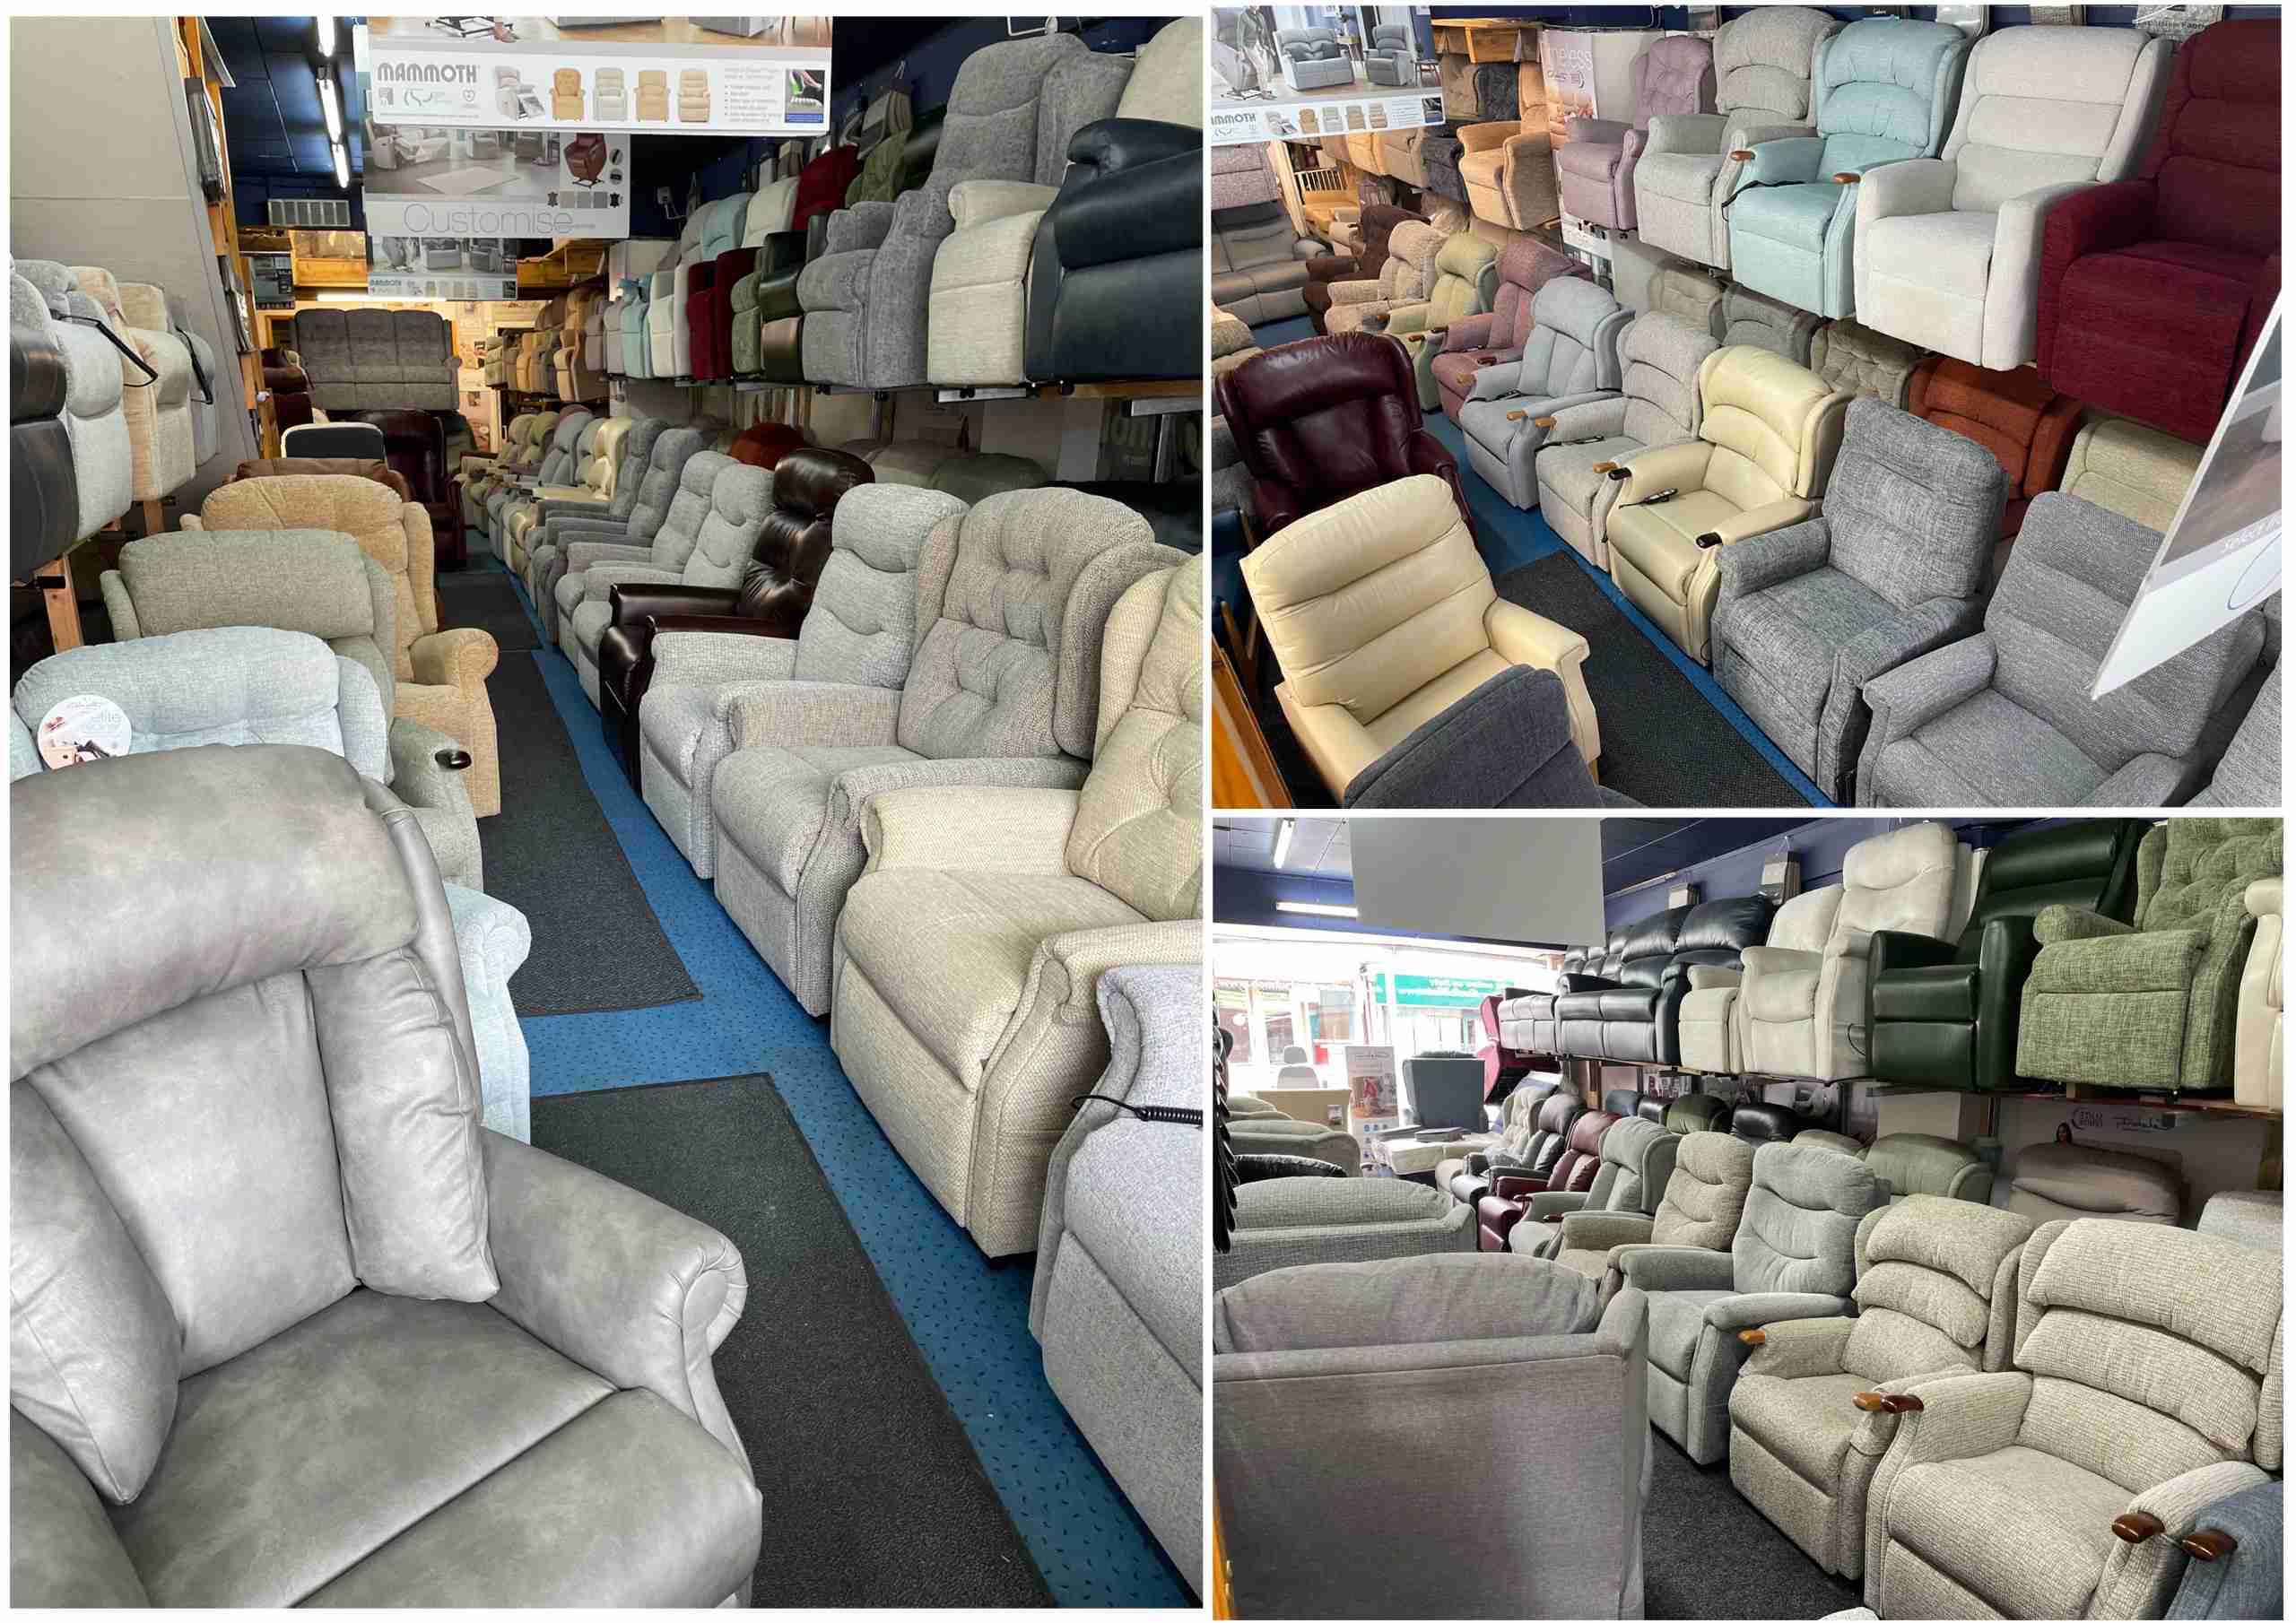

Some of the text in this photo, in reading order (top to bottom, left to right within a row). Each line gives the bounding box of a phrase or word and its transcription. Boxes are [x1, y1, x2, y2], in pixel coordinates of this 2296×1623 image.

[377, 62, 477, 82] MAMMOTH
[1211, 113, 1257, 126] MMOTH
[404, 203, 573, 235] Customise
